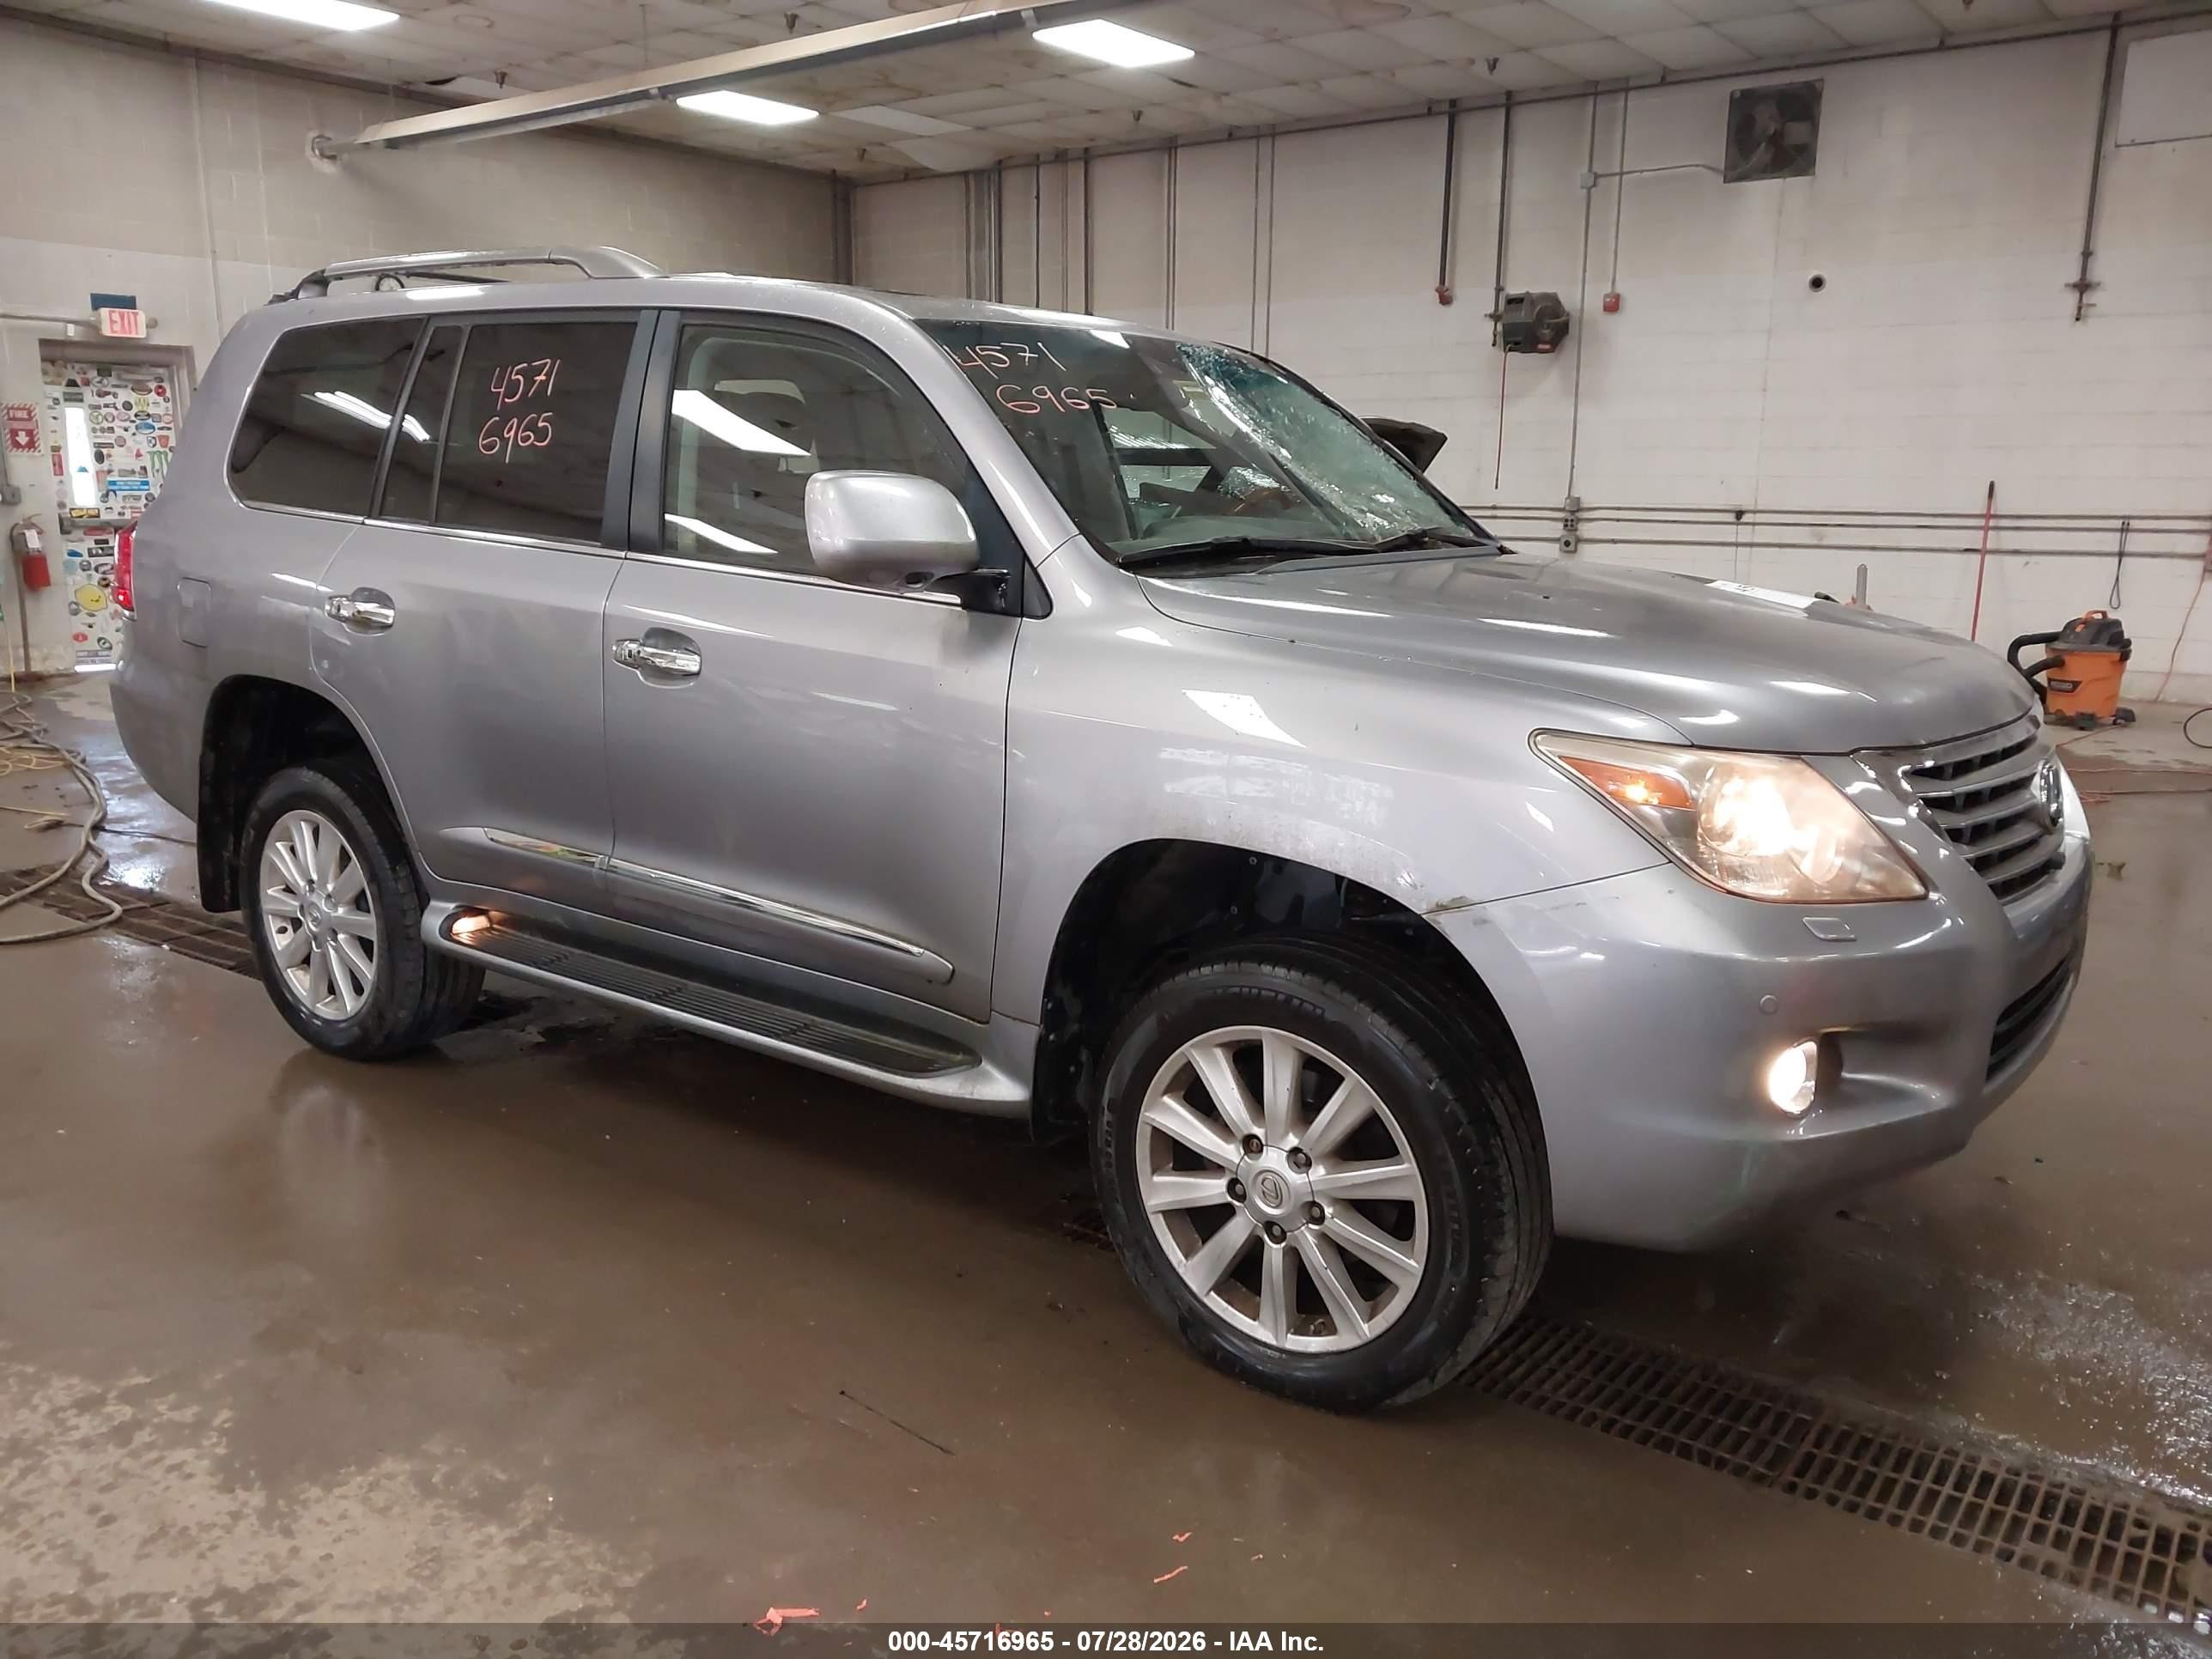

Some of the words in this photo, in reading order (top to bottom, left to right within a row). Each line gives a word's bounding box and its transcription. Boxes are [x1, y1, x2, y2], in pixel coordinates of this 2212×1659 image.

[108, 310, 139, 335] EXIT
[942, 341, 1067, 380] 4571
[490, 358, 561, 411] 4571
[995, 384, 1118, 414] 6965
[9, 410, 30, 419] FIRE
[478, 411, 554, 464] 6965
